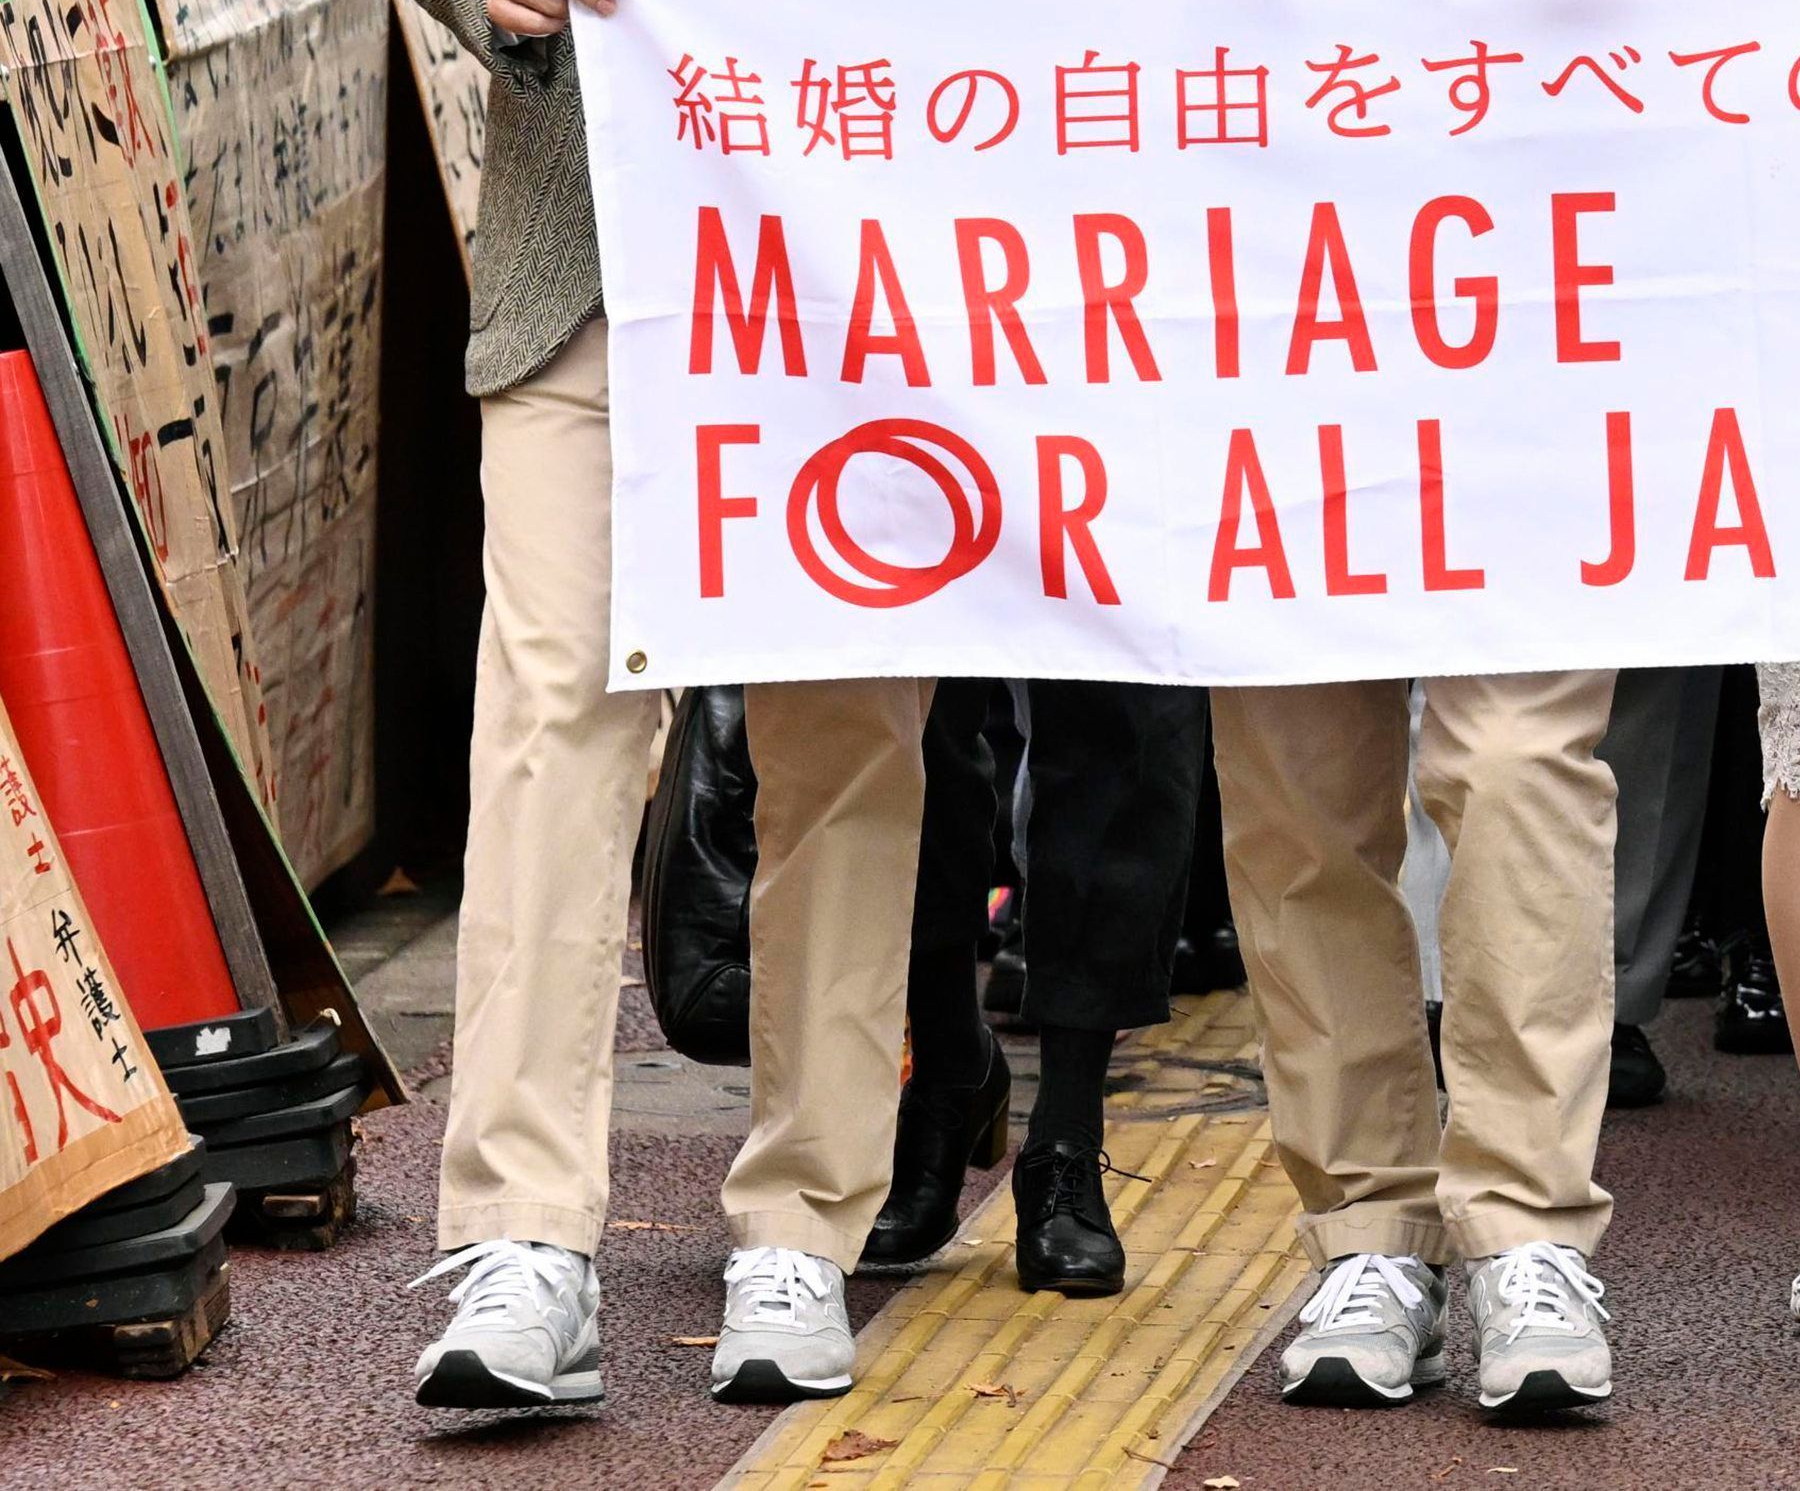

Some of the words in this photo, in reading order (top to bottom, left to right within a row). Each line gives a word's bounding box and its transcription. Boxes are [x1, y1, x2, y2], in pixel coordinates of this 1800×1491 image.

[689, 191, 1621, 388] MARRIAGE
[696, 418, 1121, 609] FOR
[1208, 419, 1485, 602] ALL
[51, 909, 137, 1083] 弁護士
